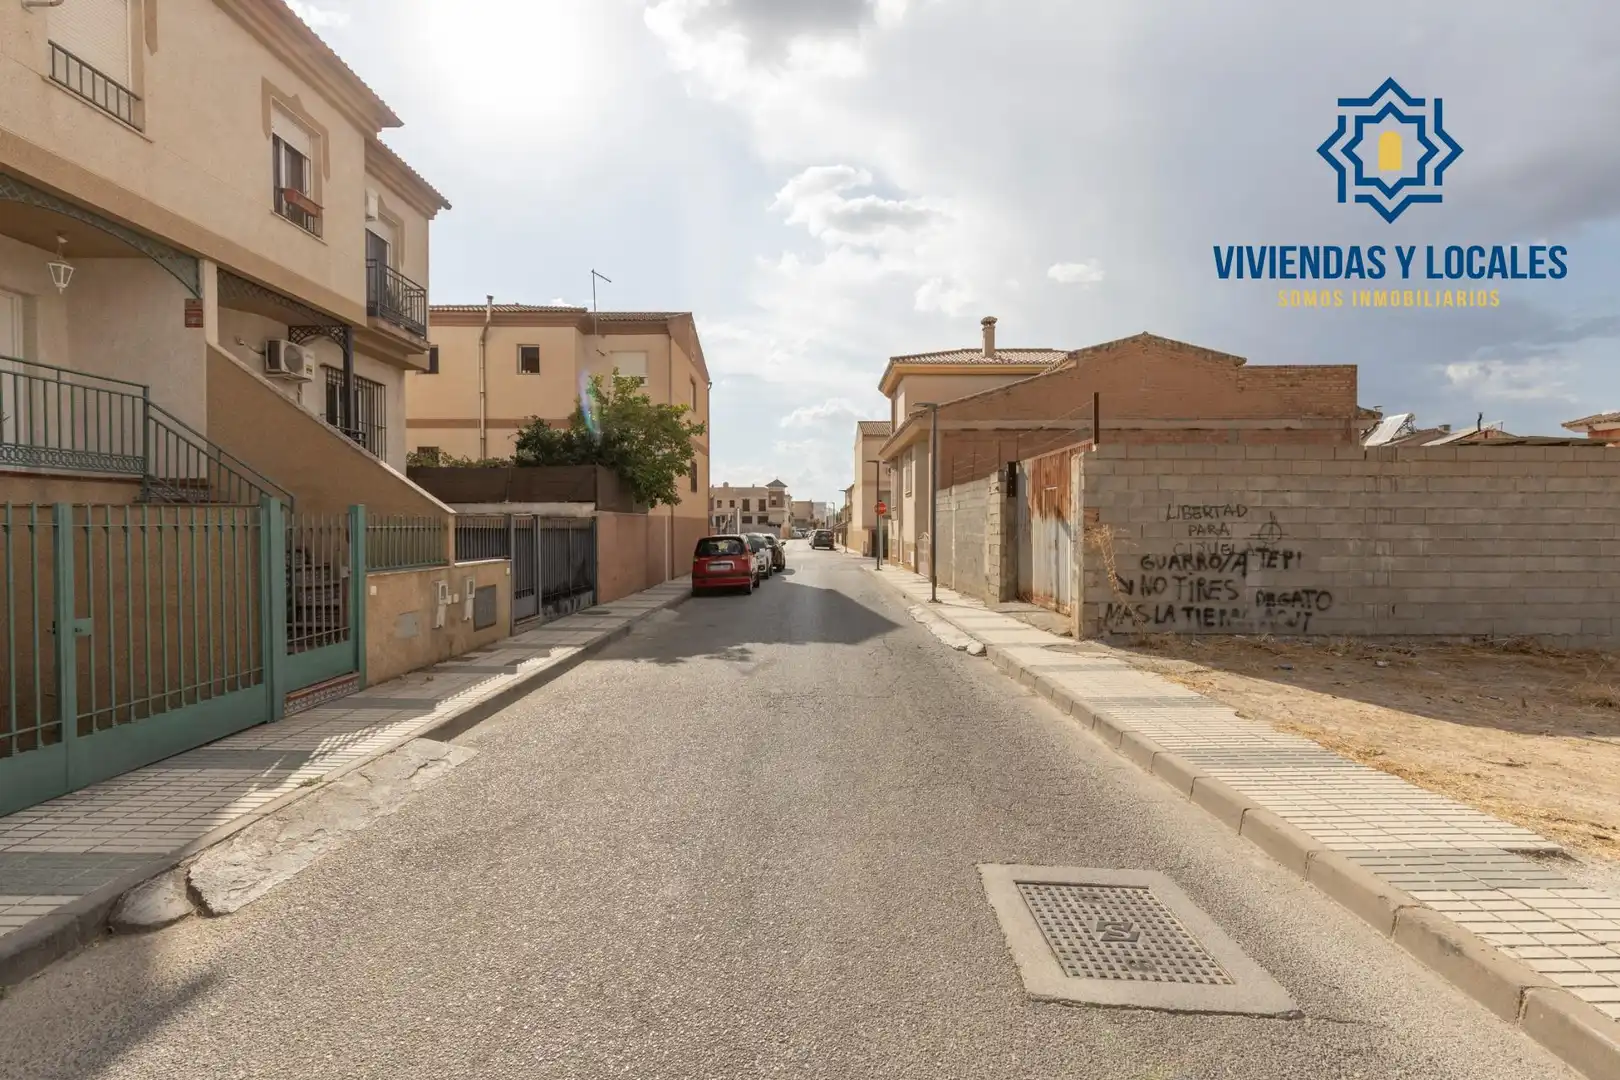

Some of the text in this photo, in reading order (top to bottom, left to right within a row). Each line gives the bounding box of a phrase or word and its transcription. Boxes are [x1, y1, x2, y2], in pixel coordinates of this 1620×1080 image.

[1166, 503, 1248, 521] LIBERTAD
[1188, 522, 1231, 537] PARA
[1140, 574, 1168, 597] NO
[1154, 604, 1177, 624] LA
